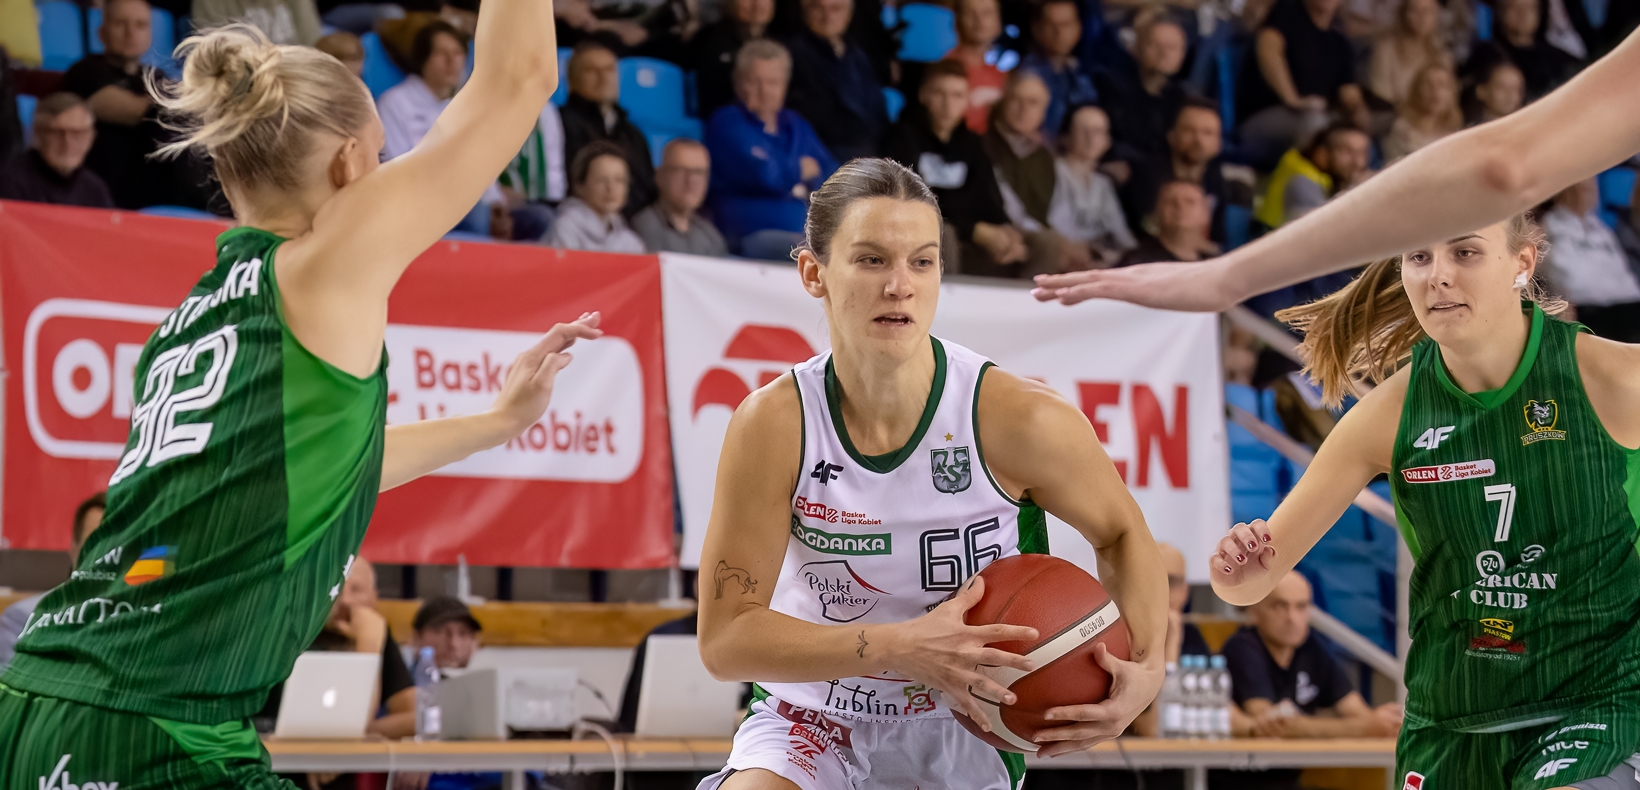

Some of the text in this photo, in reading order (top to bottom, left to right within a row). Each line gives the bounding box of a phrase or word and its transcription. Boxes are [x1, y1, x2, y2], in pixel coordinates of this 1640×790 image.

[413, 348, 509, 392] Bask
[1405, 469, 1436, 480] ORLEN
[1454, 463, 1477, 471] Basket
[1470, 468, 1492, 476] Kobiet
[841, 510, 866, 519] Basket
[1484, 483, 1516, 542] 7
[792, 517, 885, 552] BOGDANKA
[918, 516, 1001, 592] 66
[1482, 557, 1499, 571] PZU
[804, 571, 852, 594] Polski
[1475, 572, 1558, 590] ERICAN
[819, 591, 870, 607] Cukier
[1469, 589, 1529, 609] CLUB
